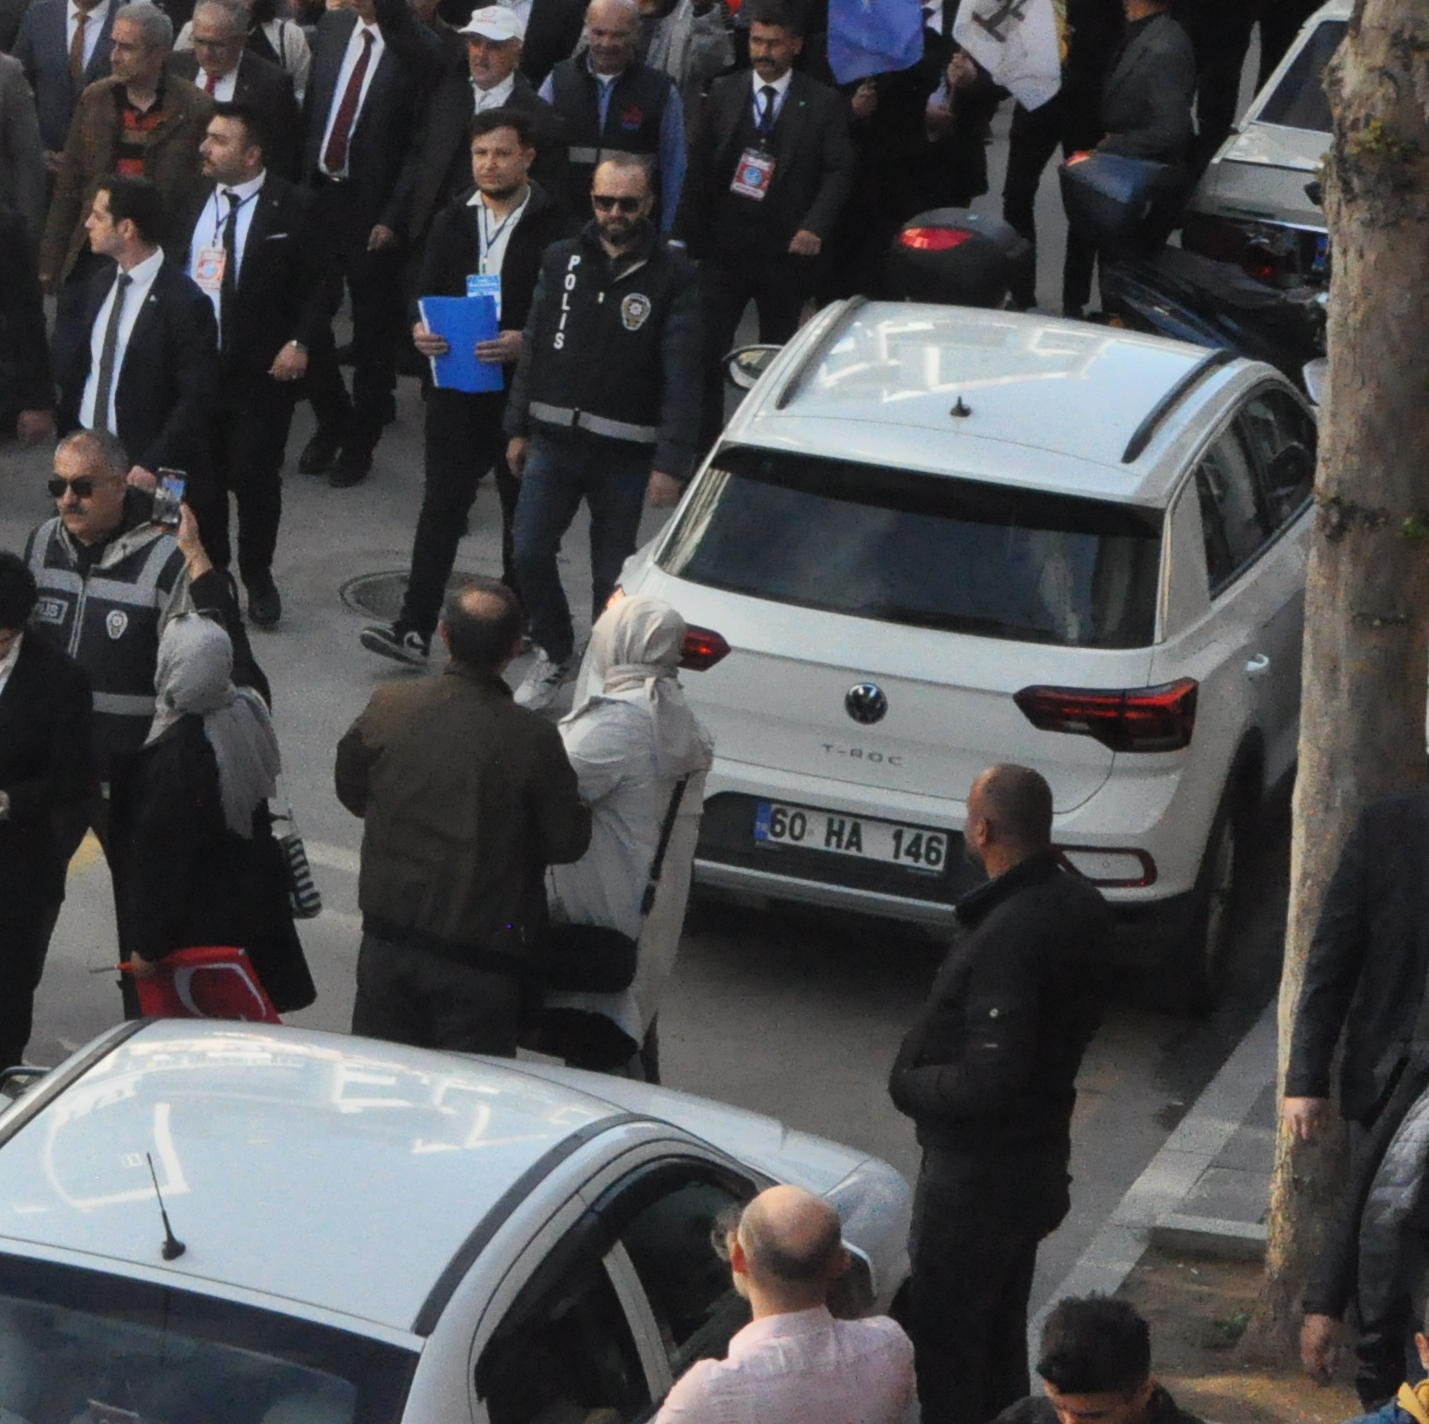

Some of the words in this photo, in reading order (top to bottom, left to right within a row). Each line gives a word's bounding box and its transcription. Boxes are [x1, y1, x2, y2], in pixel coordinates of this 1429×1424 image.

[553, 254, 581, 350] POLIS
[823, 744, 903, 766] T-ROC
[769, 807, 808, 842] 60
[824, 817, 863, 853] HA
[892, 828, 944, 866] 146
